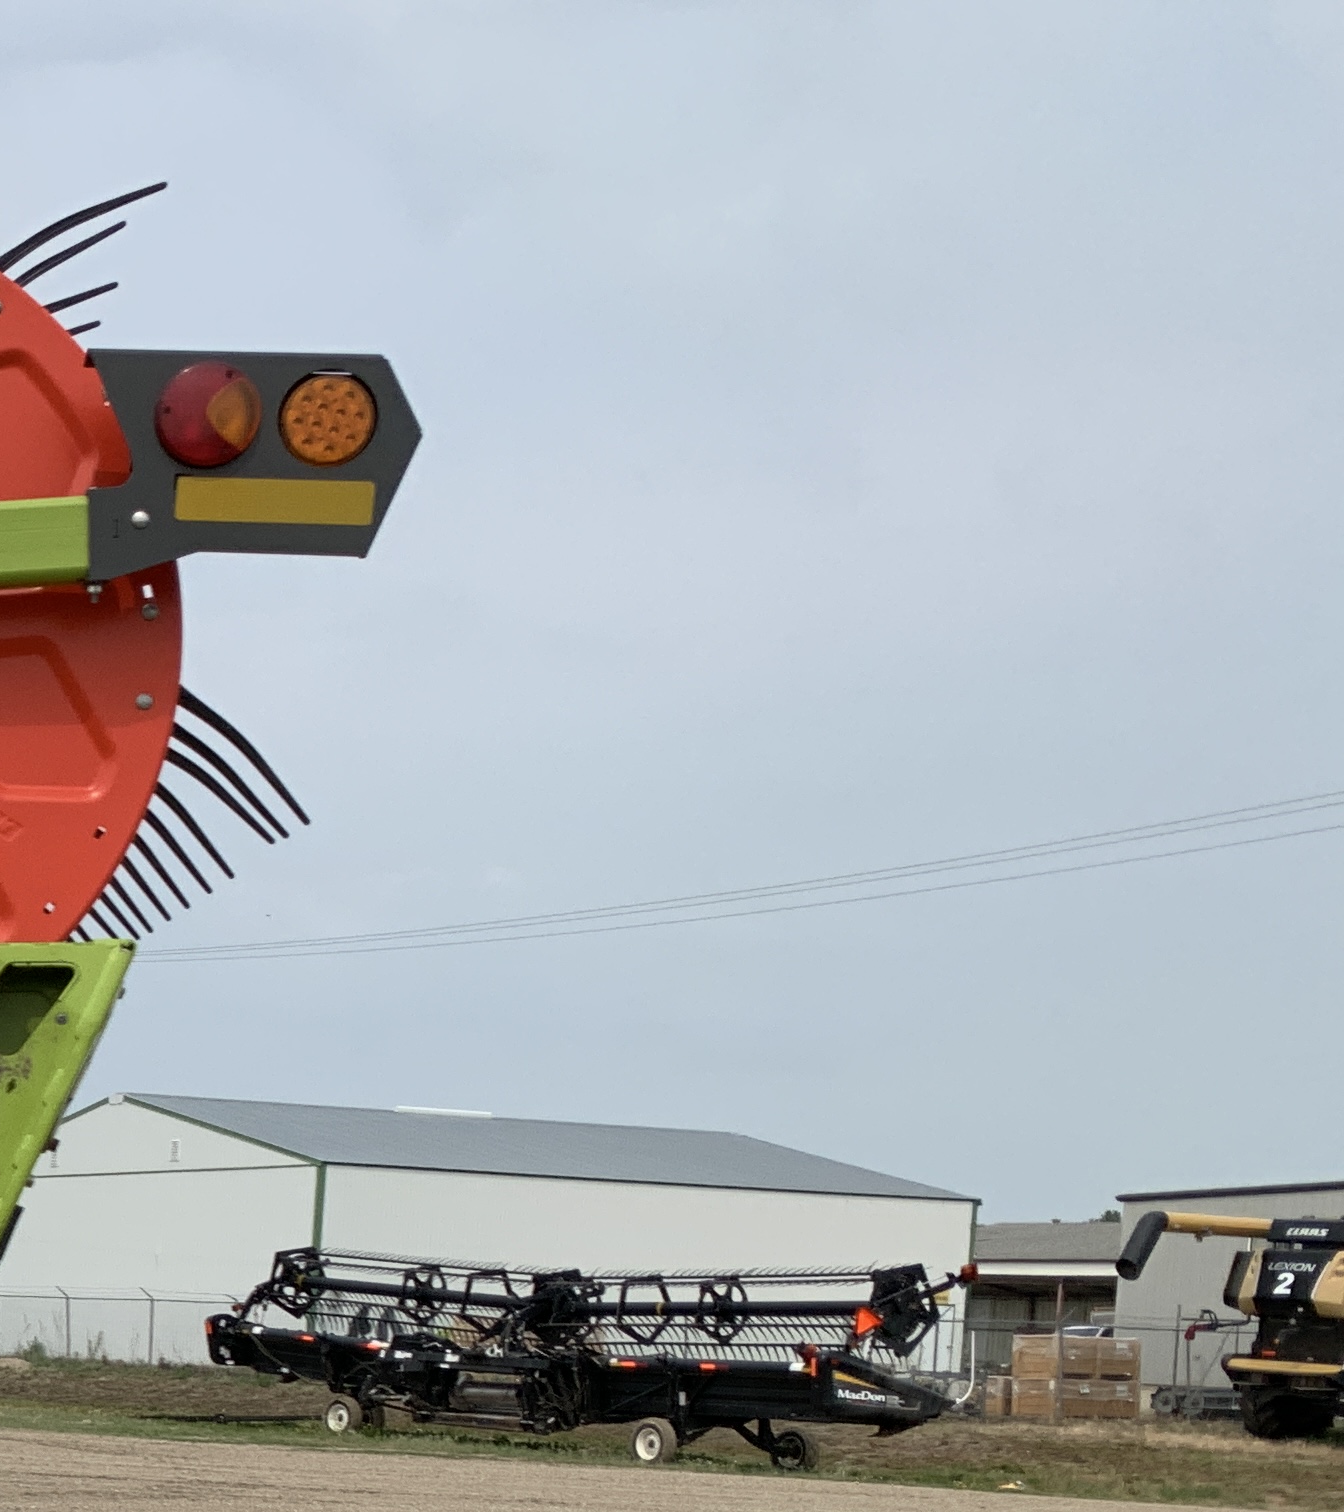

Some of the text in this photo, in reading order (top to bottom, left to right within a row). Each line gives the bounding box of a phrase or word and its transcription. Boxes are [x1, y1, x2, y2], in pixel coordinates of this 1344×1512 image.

[1285, 1227, 1330, 1237] CLAAS
[1267, 1261, 1317, 1272] LEXION
[1272, 1271, 1295, 1295] 2
[837, 1388, 886, 1402] MacDon
